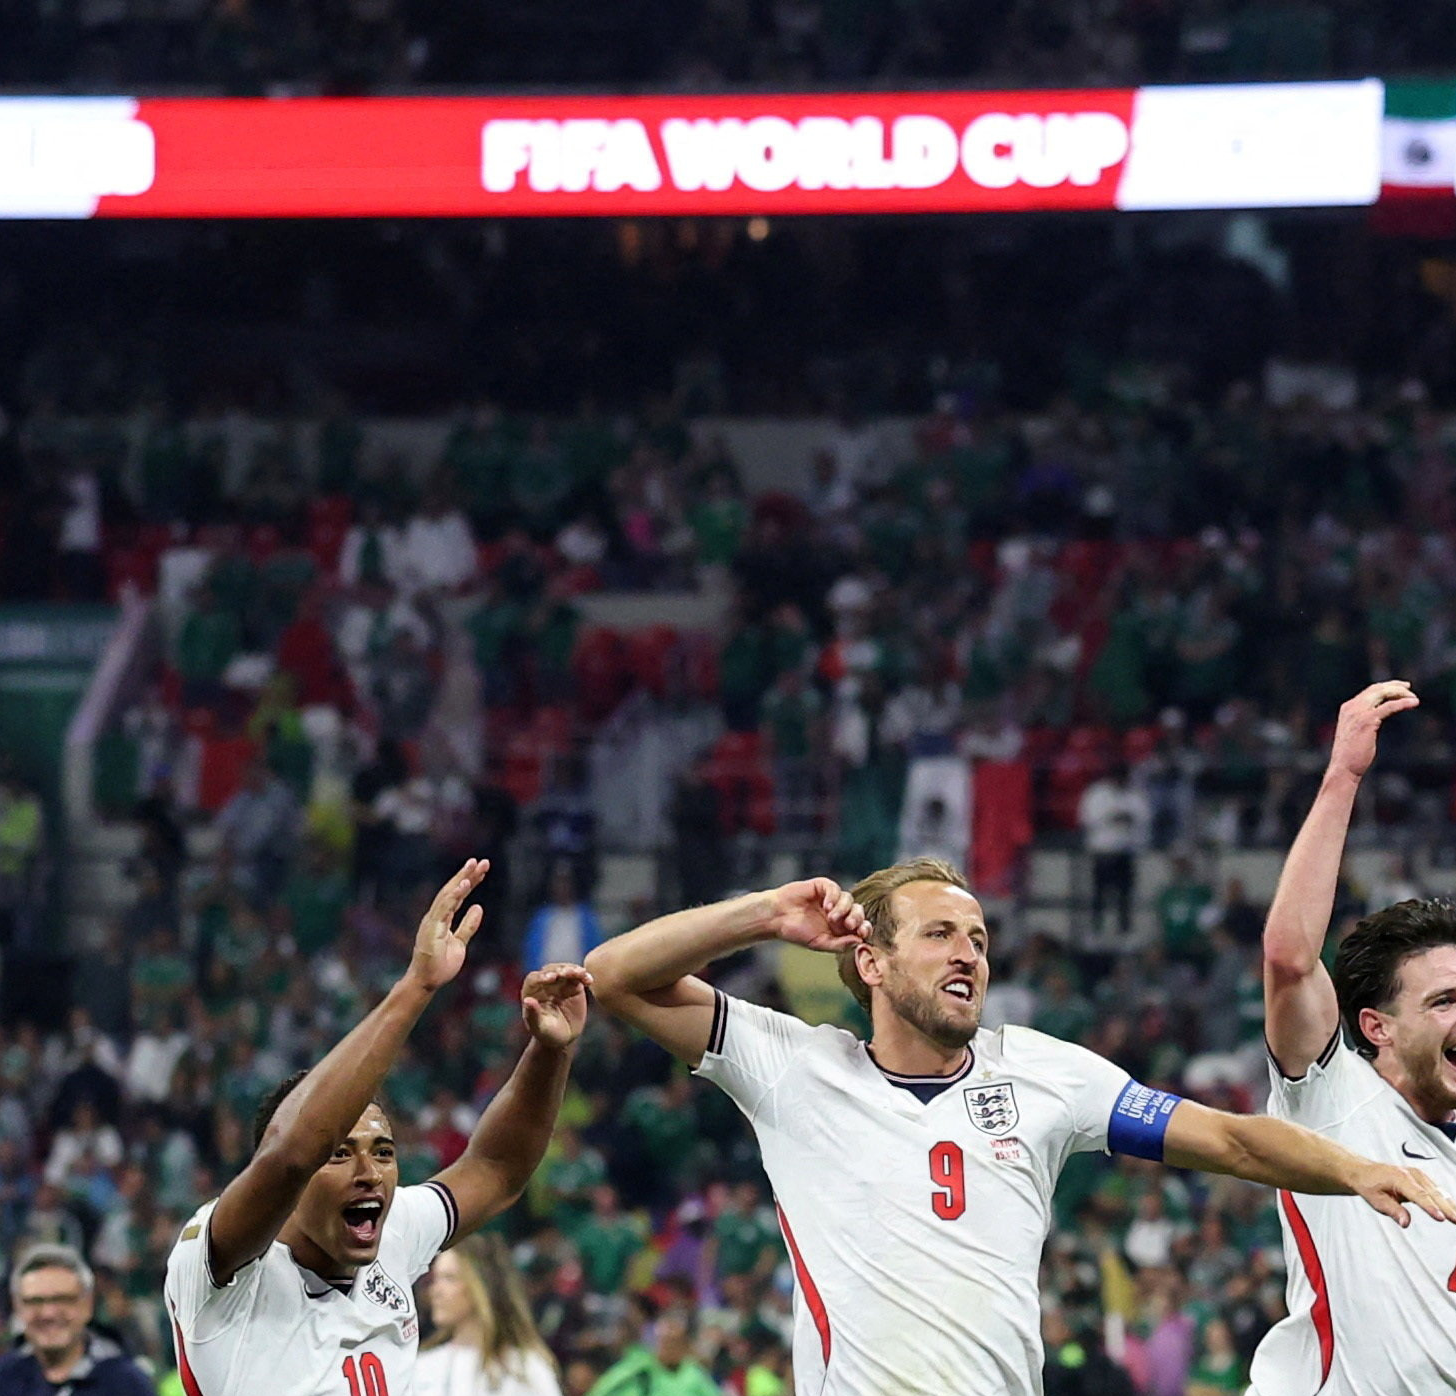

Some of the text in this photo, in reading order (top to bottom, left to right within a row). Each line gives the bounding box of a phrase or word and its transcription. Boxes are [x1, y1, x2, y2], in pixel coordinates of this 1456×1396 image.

[481, 112, 1131, 192] FIFA WORLD CUP
[929, 1140, 966, 1221] 9
